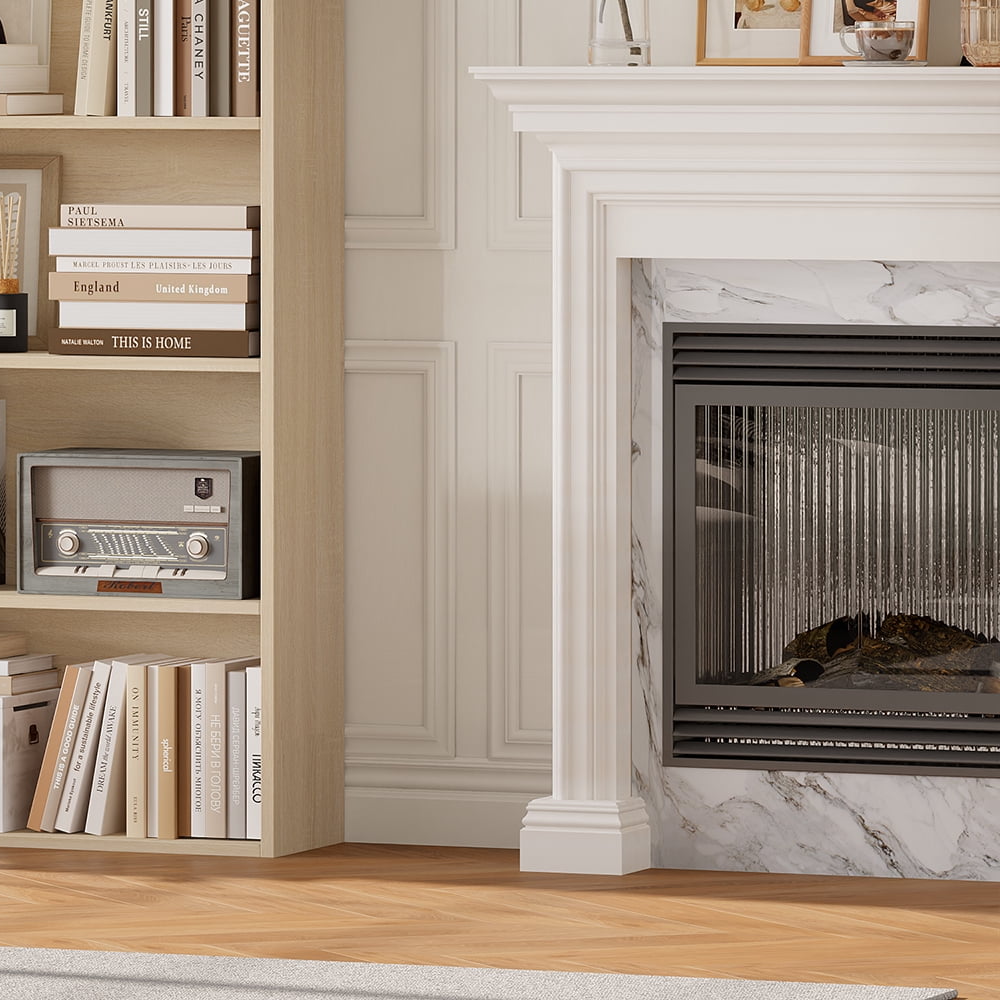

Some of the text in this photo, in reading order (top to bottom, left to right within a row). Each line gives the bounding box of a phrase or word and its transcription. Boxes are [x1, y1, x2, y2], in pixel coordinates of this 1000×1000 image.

[138, 8, 149, 41] STILL
[181, 16, 191, 43] Paris
[194, 13, 204, 80] CHANEY
[67, 217, 125, 227] SIETSEMA
[68, 206, 98, 216] PAUL
[73, 261, 233, 271] MARCEL PROUST LES LES JOURS
[73, 280, 228, 297] England United Kingdom
[61, 338, 82, 346] NATALIE
[111, 335, 139, 349] THIS
[142, 336, 151, 349] IS
[155, 336, 191, 350] HOME
[132, 687, 139, 701] ON
[79, 712, 94, 755] sustainable
[88, 681, 102, 711] lifestyle
[210, 714, 221, 729] НЕ
[53, 772, 64, 790] THIS
[62, 731, 74, 755] GOOD
[68, 704, 81, 729] GUIDE
[96, 761, 108, 793] DREAM
[106, 705, 117, 736] AWAKE
[160, 738, 173, 773] spherical
[210, 731, 221, 759] БЕРИ
[210, 771, 221, 814] ГОЛОВУ
